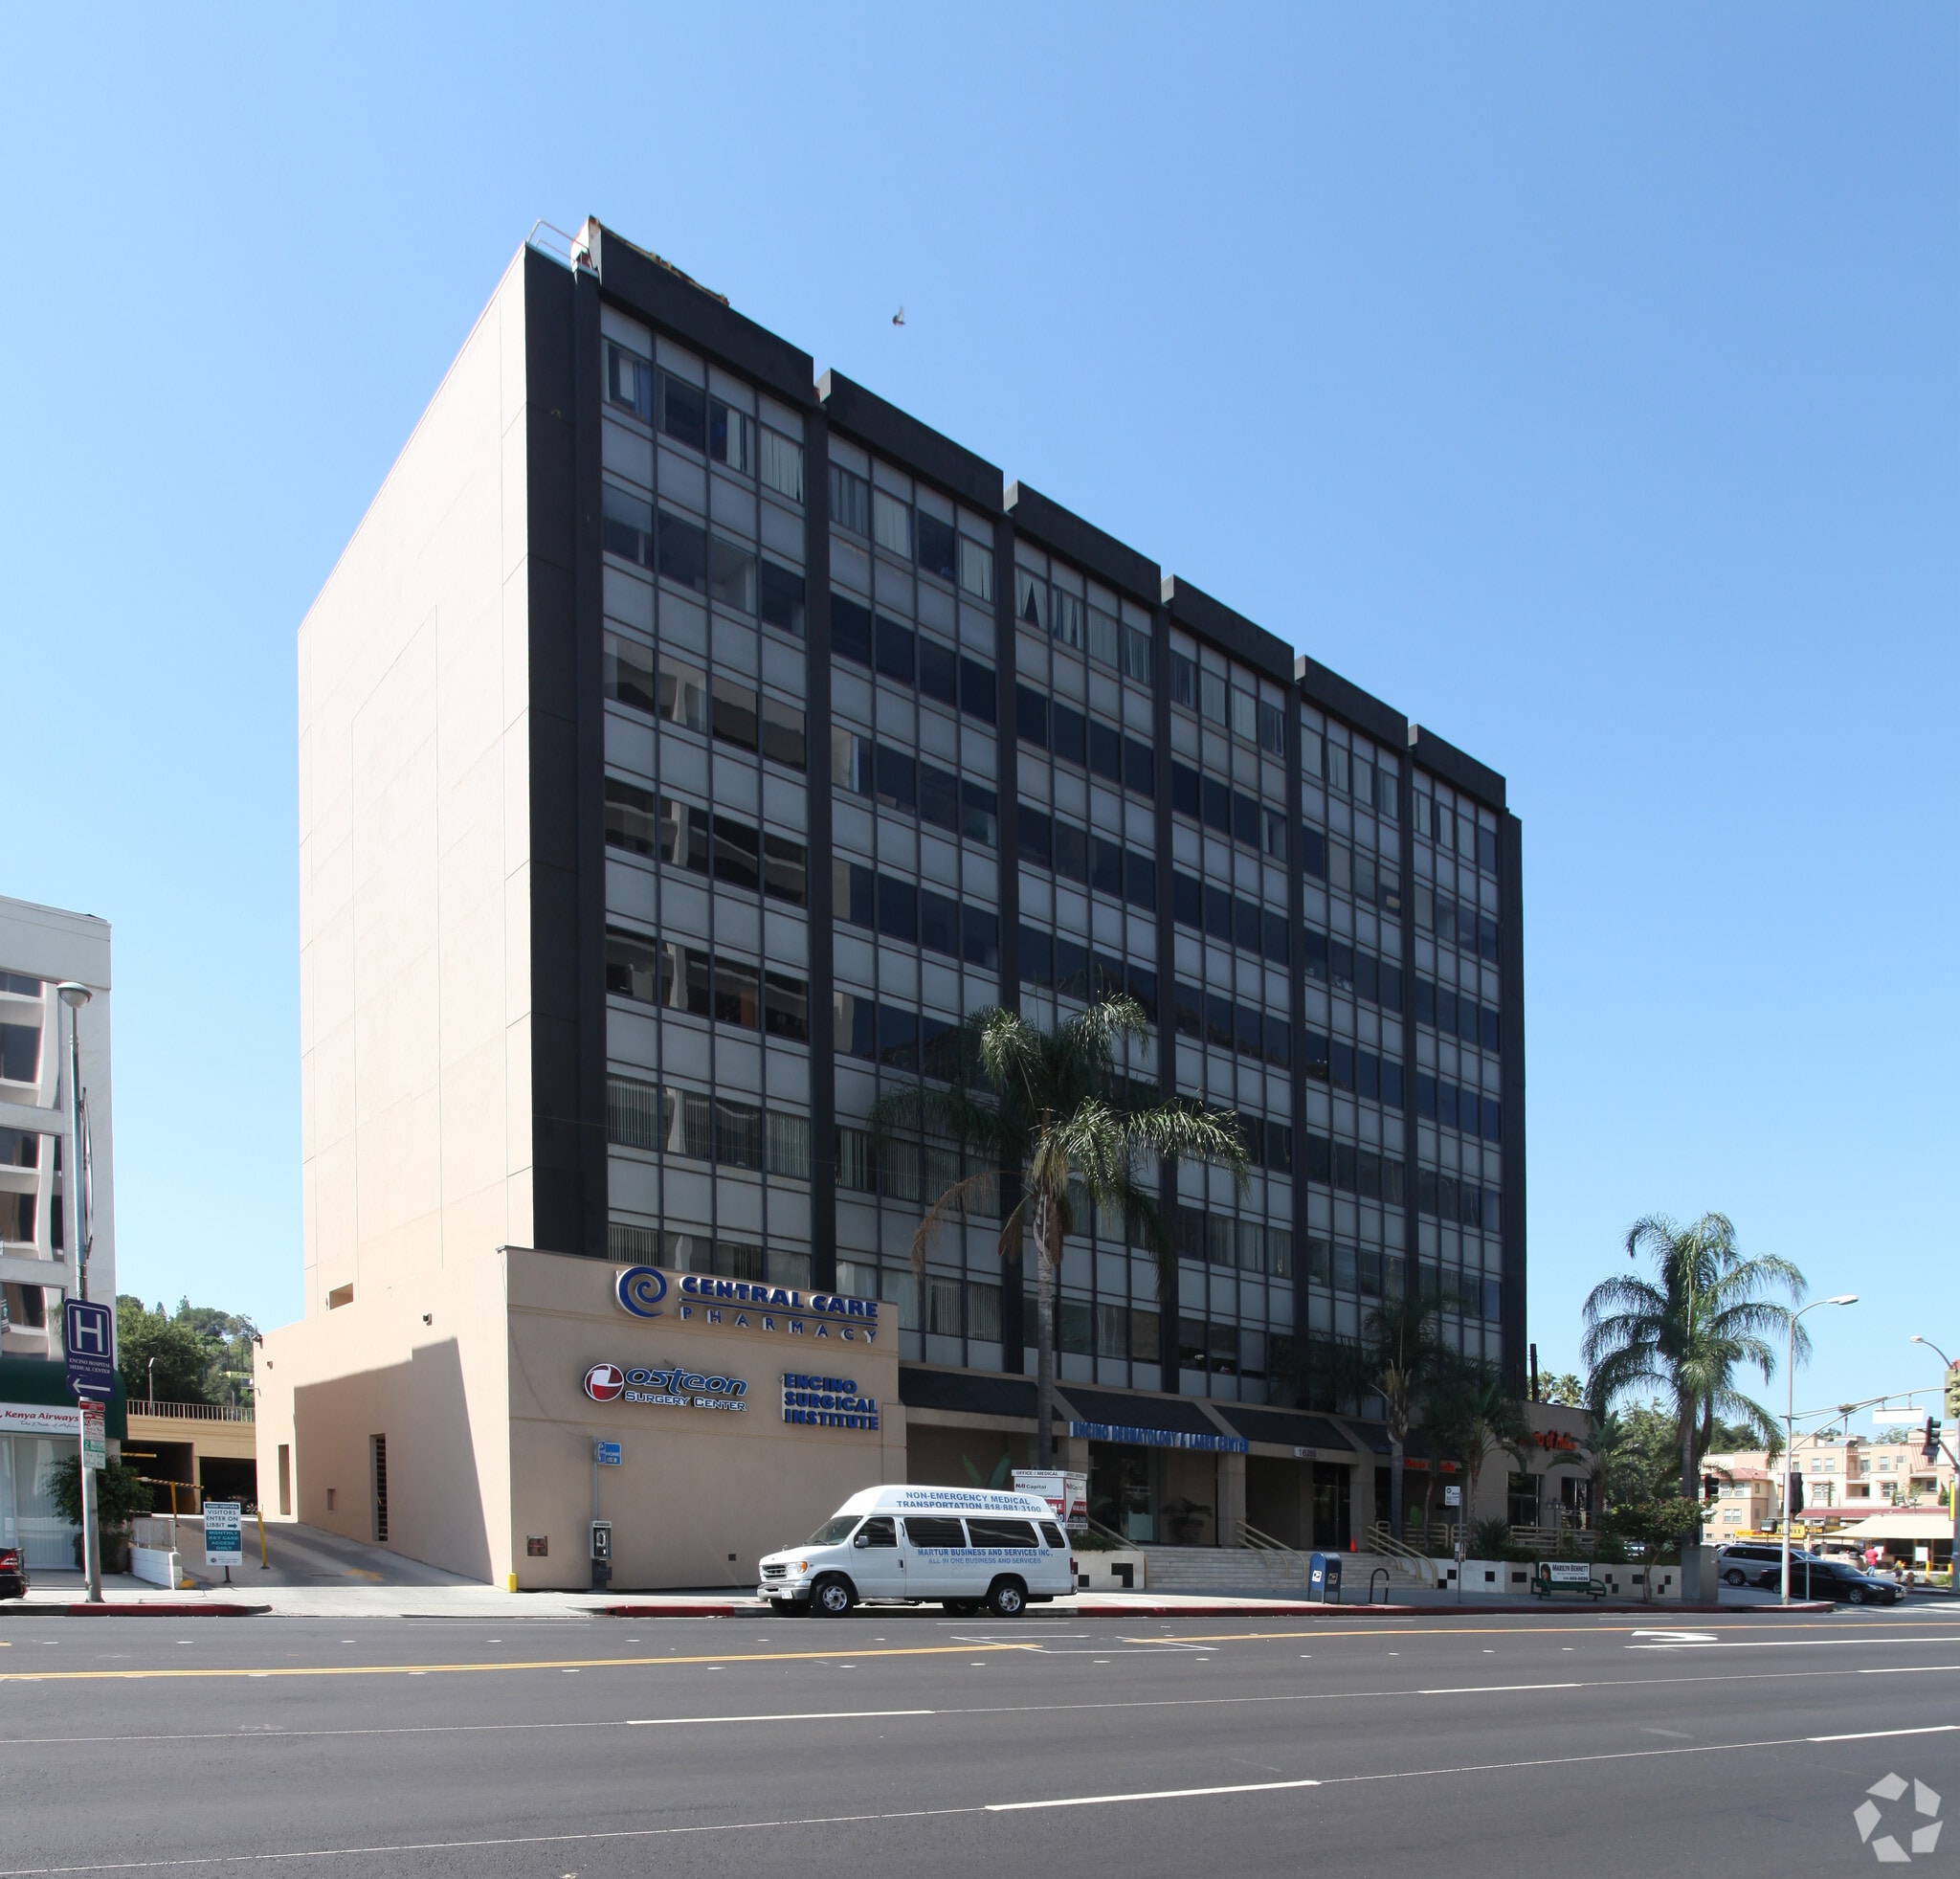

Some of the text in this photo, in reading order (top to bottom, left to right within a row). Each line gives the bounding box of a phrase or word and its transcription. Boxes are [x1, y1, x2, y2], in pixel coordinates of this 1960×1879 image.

[679, 1276, 879, 1318] CENTRAL CARE
[75, 1309, 103, 1353] H
[679, 1306, 878, 1344] PHARMACY
[89, 1360, 111, 1369] HOSPITAL
[625, 1367, 748, 1397] osteon
[784, 1373, 858, 1395] ENCINO
[624, 1390, 748, 1412] SURGERY CENTER
[784, 1391, 879, 1414] SURGICAL
[5, 1410, 36, 1420] Kenya
[38, 1412, 79, 1422] Airways
[784, 1408, 880, 1431] INSTITUTE
[897, 1500, 982, 1510] TRANSPORTATION
[905, 1491, 1031, 1505] NON-EMERGENCY MEDICAL
